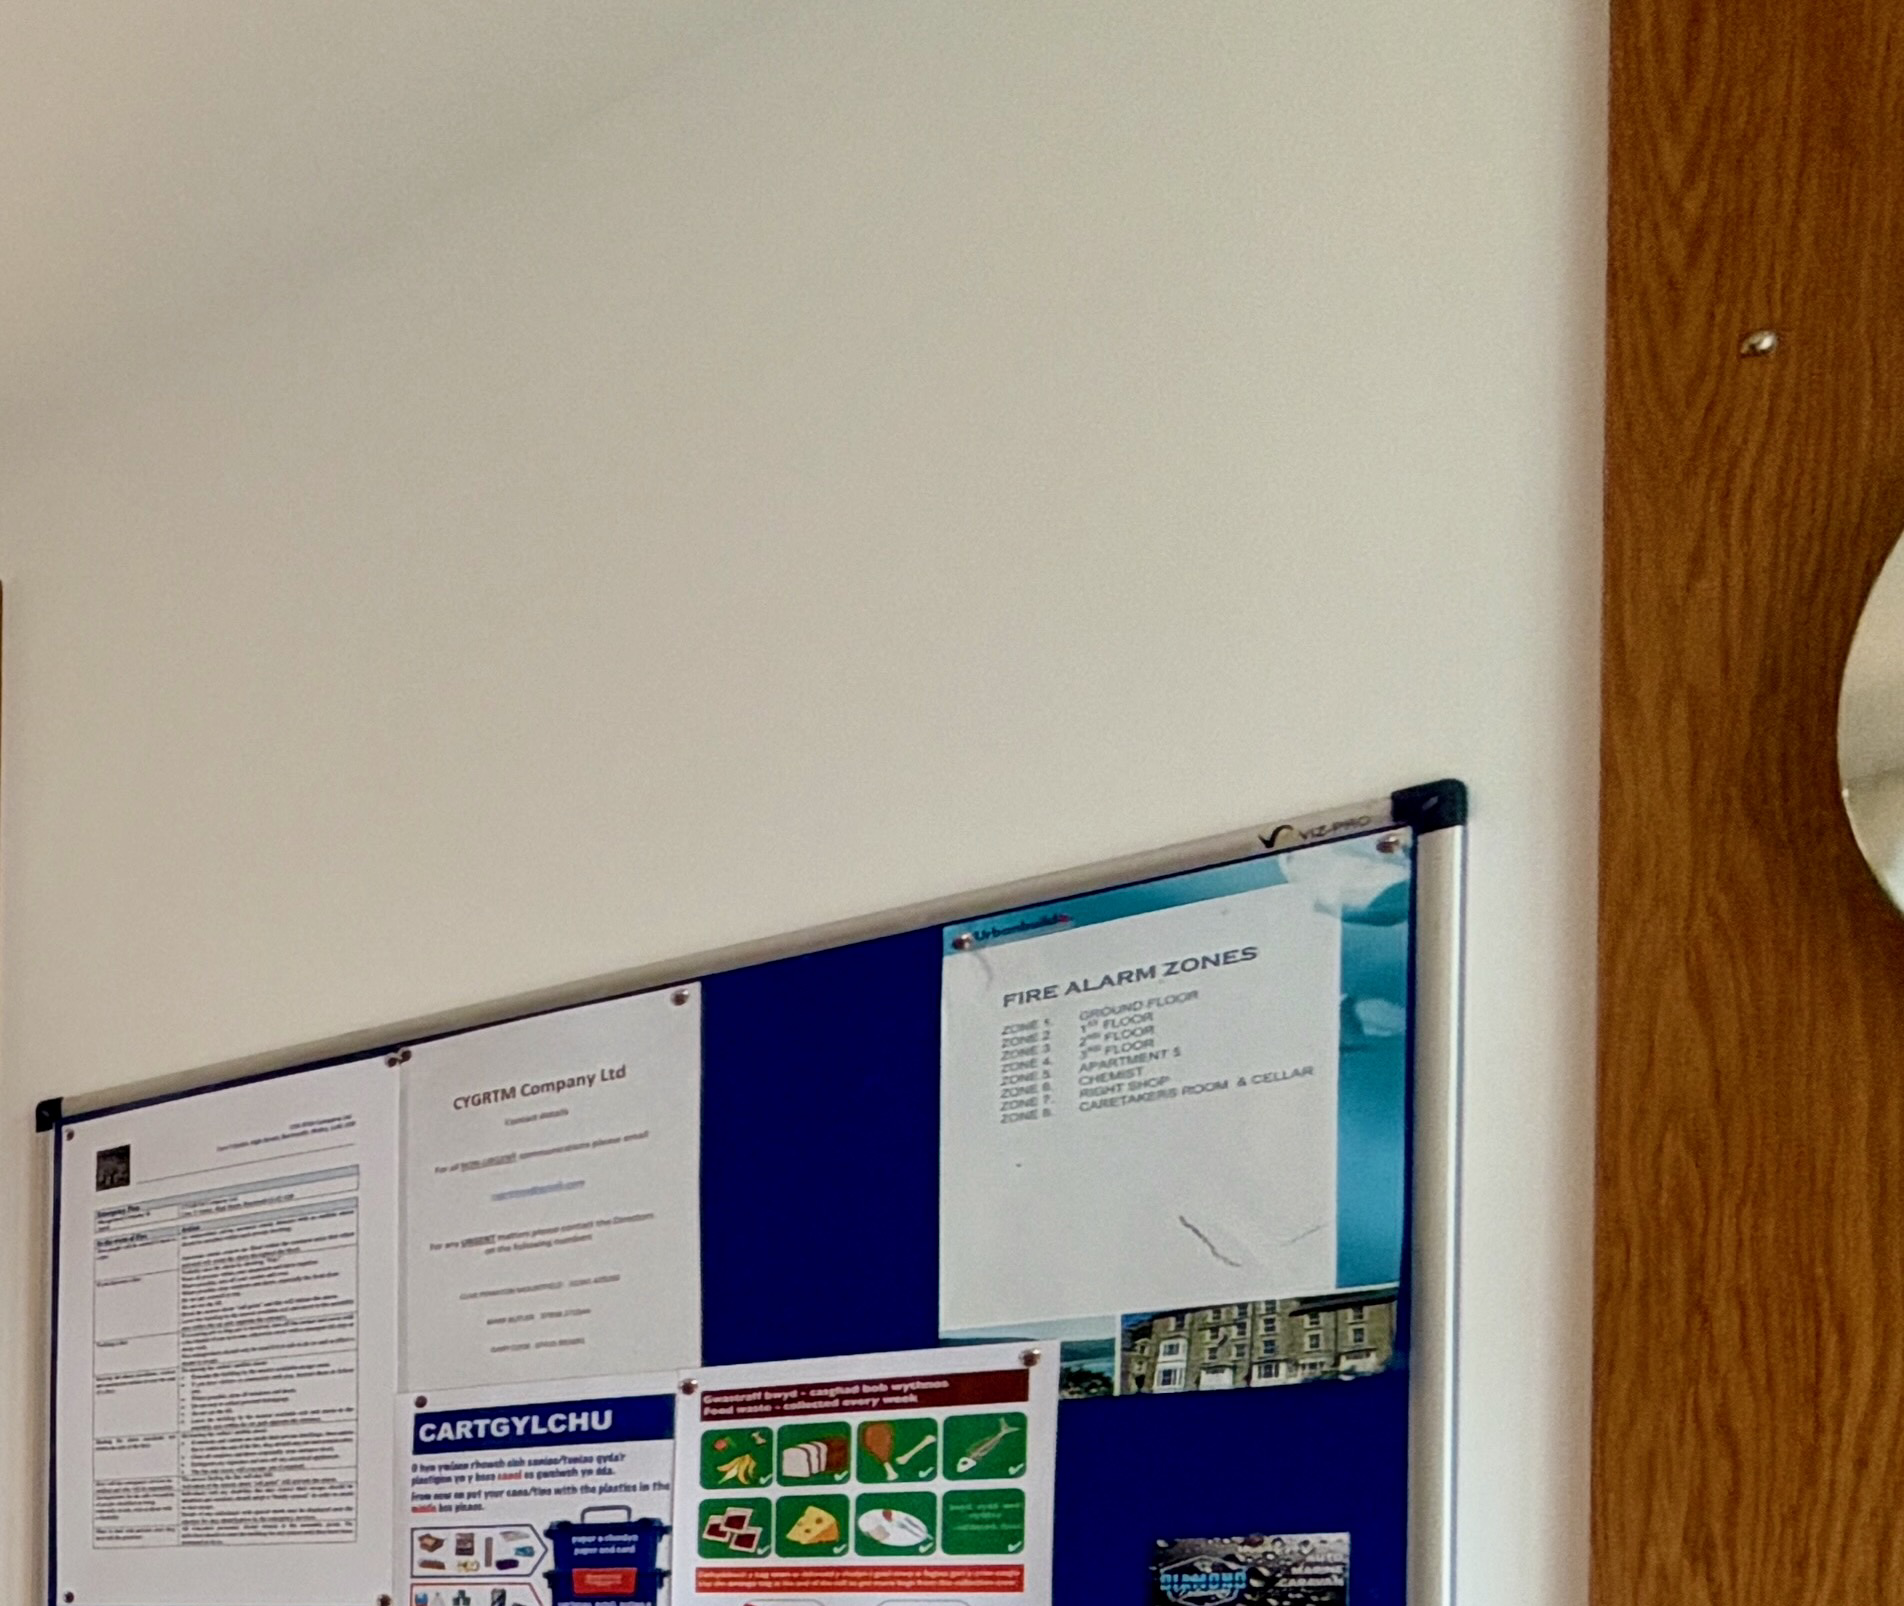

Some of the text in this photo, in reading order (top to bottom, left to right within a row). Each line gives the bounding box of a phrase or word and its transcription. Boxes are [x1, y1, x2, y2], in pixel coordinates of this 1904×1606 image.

[1003, 946, 1259, 1008] FIRE ALARM ZONES
[1079, 1000, 1143, 1021] GROUND
[1147, 989, 1199, 1008] FLOOR
[1103, 1011, 1154, 1029] FLOOR
[1104, 1025, 1154, 1041] FLOOR
[1104, 1038, 1154, 1055] FLOOR
[1078, 1049, 1169, 1073] APARTMENT
[452, 1064, 627, 1111] CYGRTM Company Ltd
[1078, 1066, 1144, 1086] CHEMIST
[1128, 1075, 1171, 1091] SHOP
[1079, 1087, 1177, 1112] CARETAKERS
[1182, 1079, 1229, 1096] ROOM
[1251, 1066, 1314, 1086] CELLAR
[703, 1405, 734, 1416] Food
[736, 1403, 772, 1414] waste
[783, 1398, 840, 1410] collected
[842, 1397, 880, 1408] every
[882, 1393, 918, 1404] week
[418, 1409, 613, 1442] CARTGYLCHU
